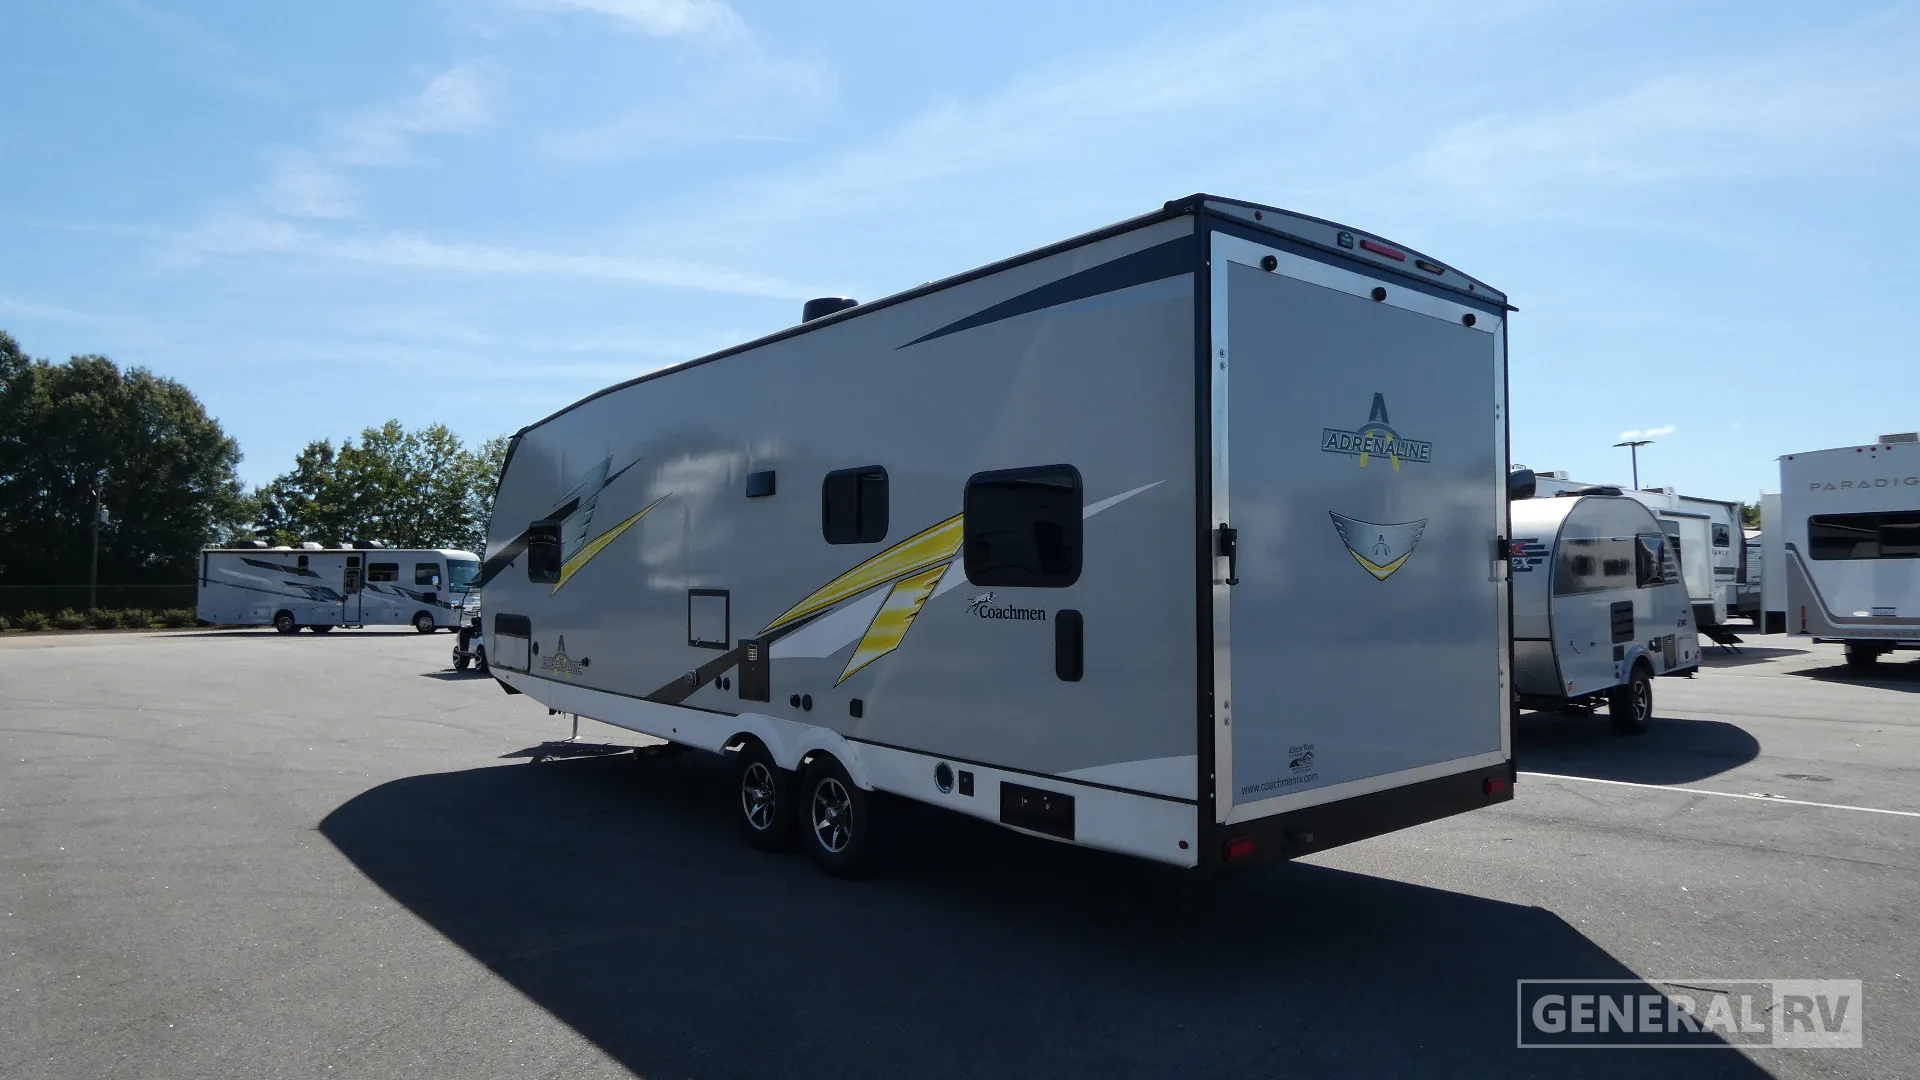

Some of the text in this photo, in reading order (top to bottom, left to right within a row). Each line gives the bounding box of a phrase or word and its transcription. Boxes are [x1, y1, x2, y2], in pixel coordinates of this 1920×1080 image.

[1323, 432, 1430, 460] ADRENALINE
[1809, 476, 1920, 491] PARADIG
[980, 604, 1046, 620] Coachmen
[1241, 773, 1319, 795] www.coachmenrv.com
